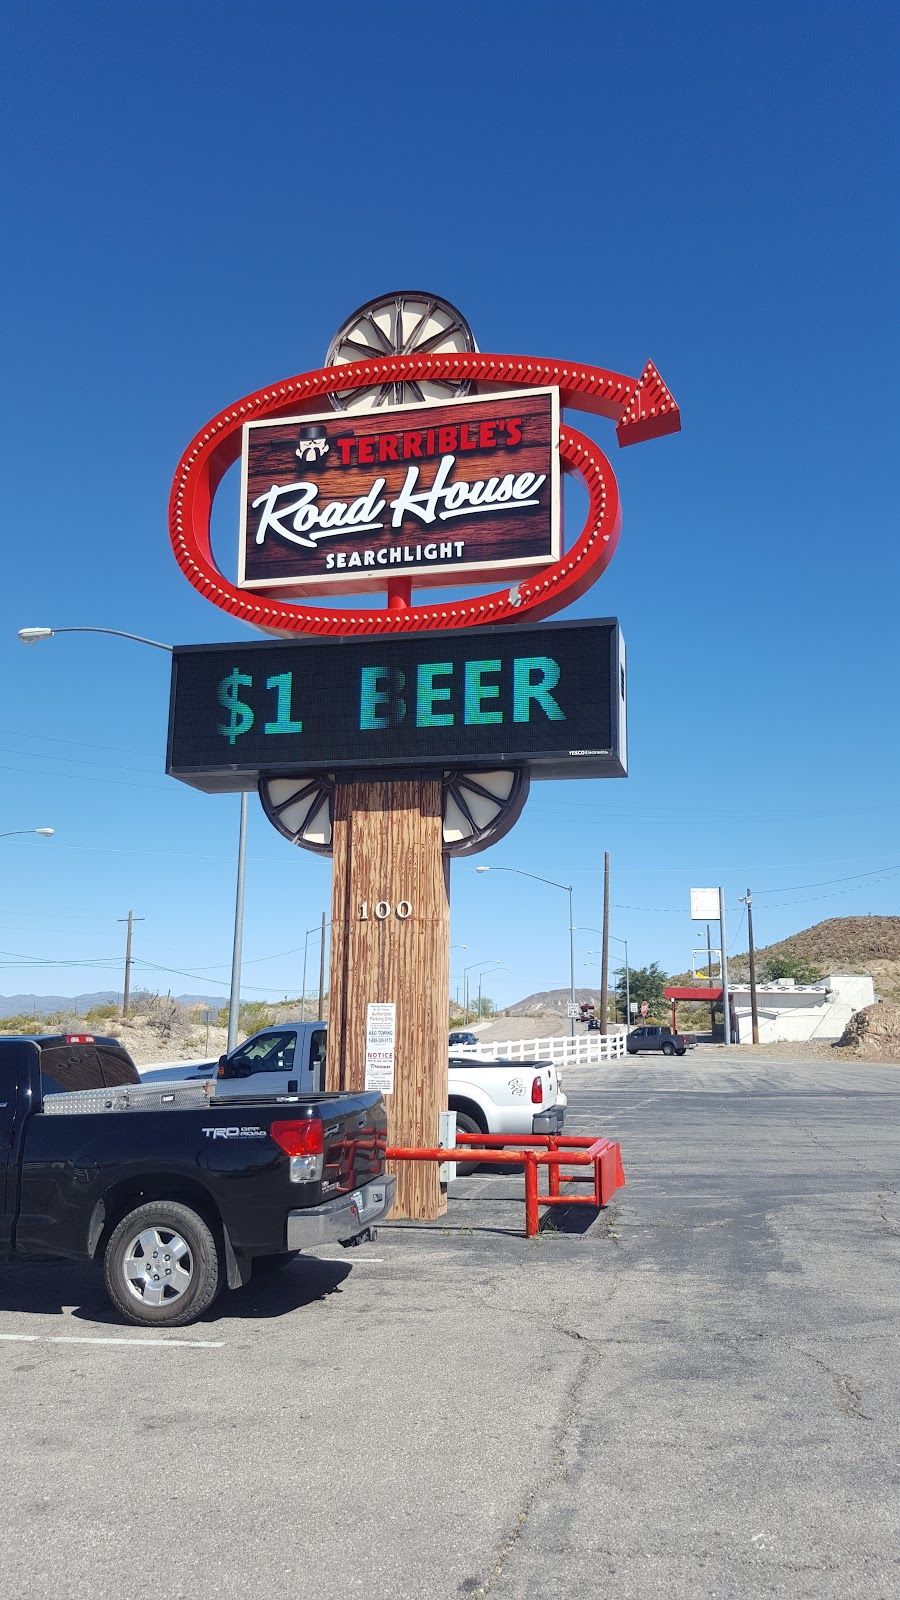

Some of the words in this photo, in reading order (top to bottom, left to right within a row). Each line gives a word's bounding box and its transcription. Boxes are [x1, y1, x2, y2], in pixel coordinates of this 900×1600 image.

[337, 418, 524, 465] TERRIBLE'S
[252, 478, 386, 548] Road
[389, 455, 547, 528] House
[325, 541, 465, 570] SEARCHLIGHT
[216, 667, 303, 745] $1
[359, 656, 567, 730] BEER
[359, 900, 413, 920] 100
[201, 1126, 240, 1140] TRD
